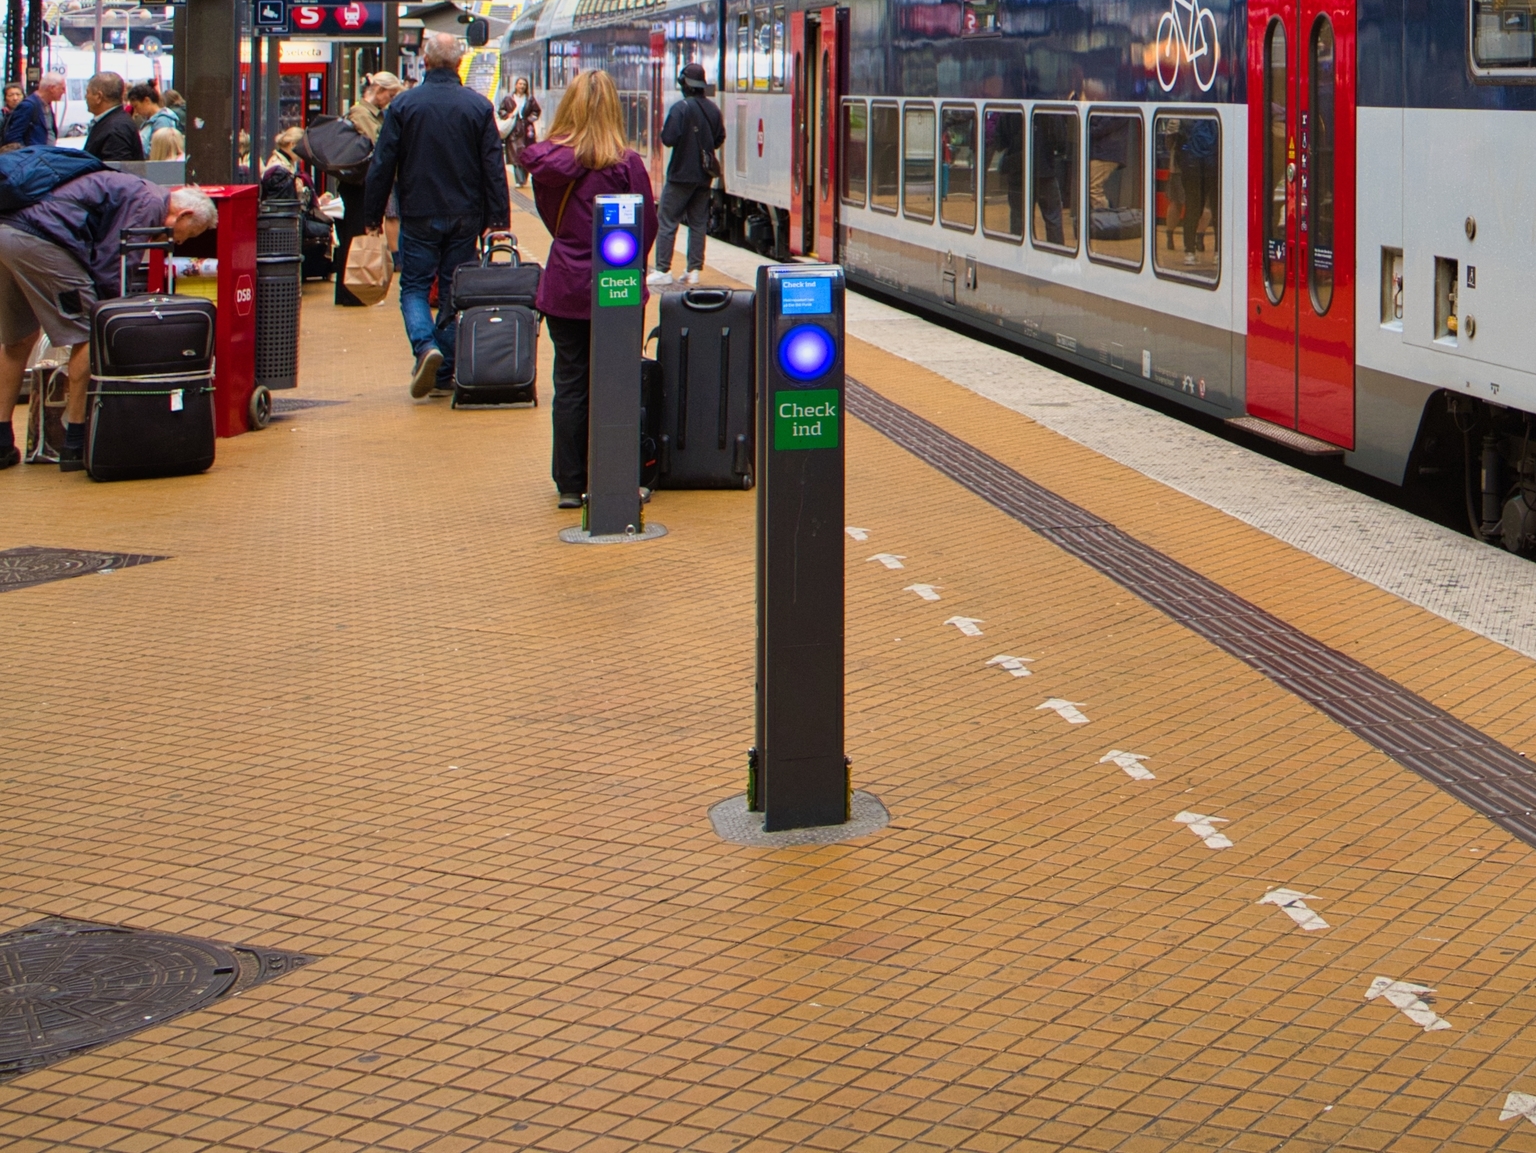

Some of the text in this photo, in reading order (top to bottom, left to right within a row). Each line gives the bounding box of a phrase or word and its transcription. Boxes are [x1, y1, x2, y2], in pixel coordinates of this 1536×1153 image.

[300, 6, 319, 25] S
[286, 47, 322, 57] selecta
[600, 276, 638, 288] Check
[236, 289, 251, 302] DSB
[609, 288, 629, 298] ind
[779, 402, 836, 418] Check
[792, 422, 822, 437] ind
